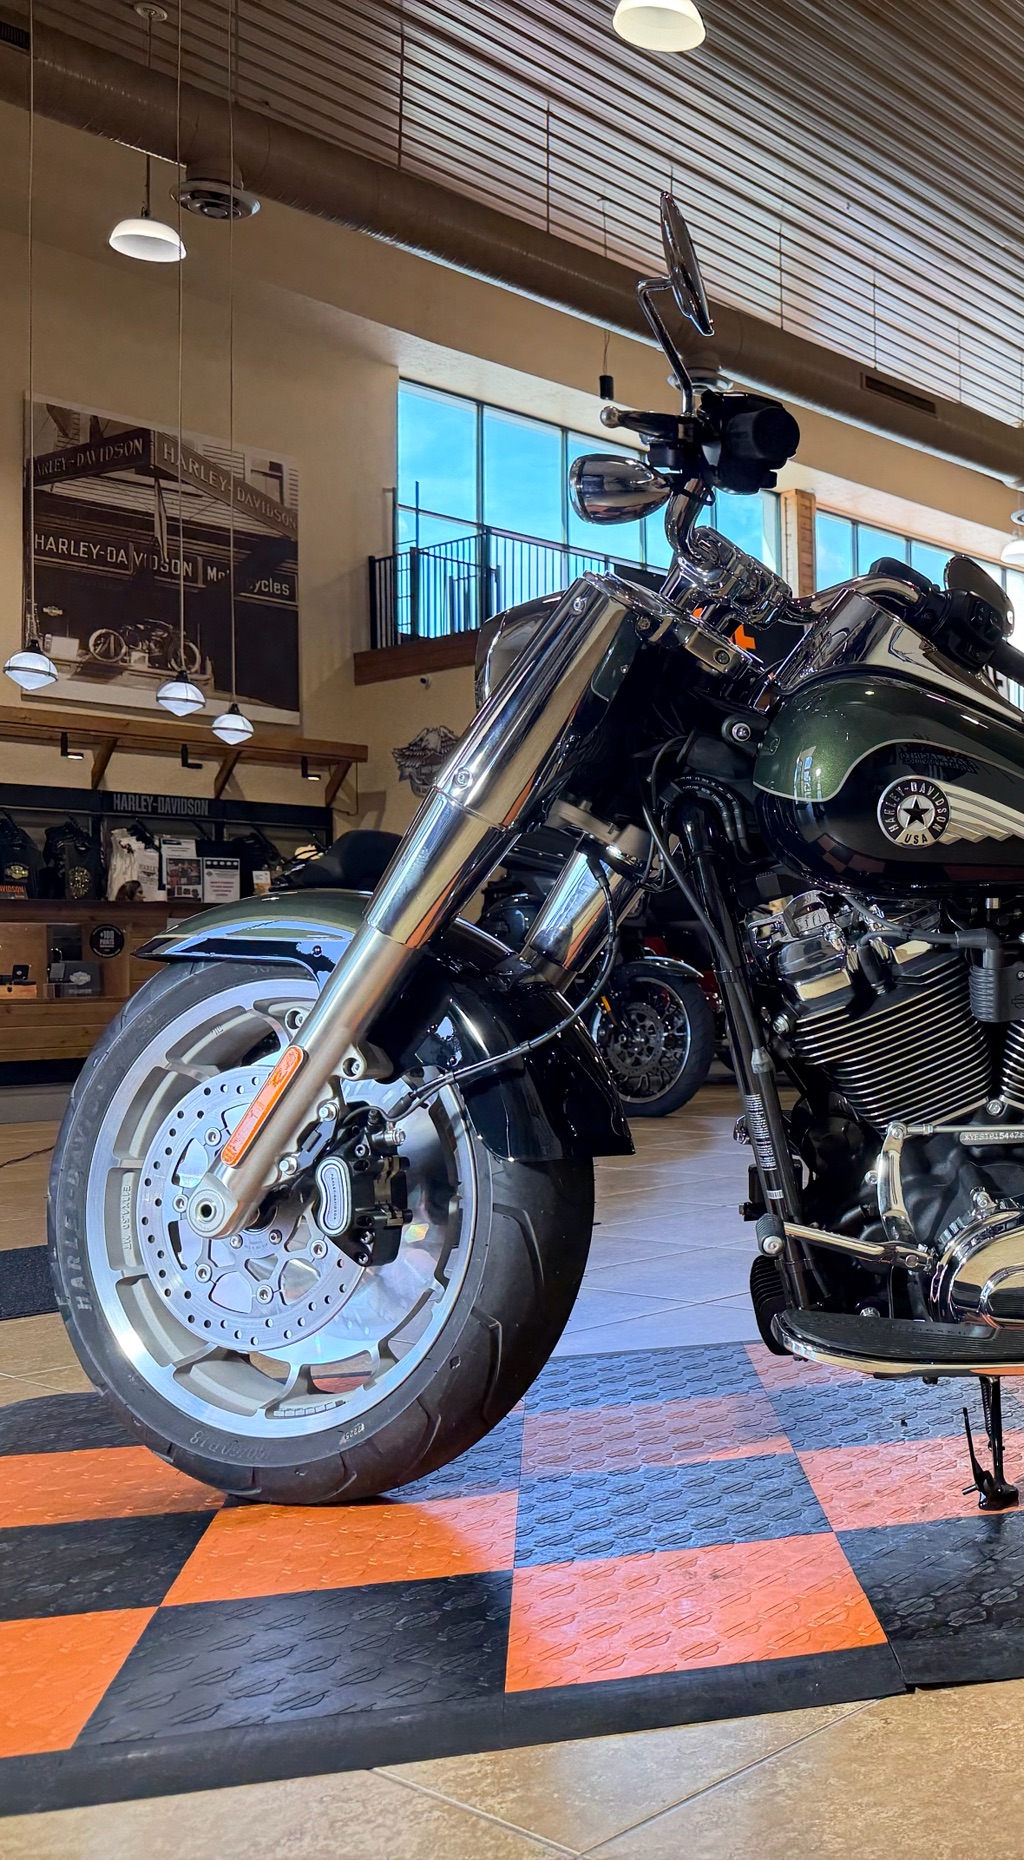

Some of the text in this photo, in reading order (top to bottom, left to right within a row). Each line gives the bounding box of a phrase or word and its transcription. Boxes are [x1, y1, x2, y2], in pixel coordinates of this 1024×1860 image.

[35, 438, 143, 476] ARLEY-DAVIDSON
[113, 793, 209, 816] HARLEY-DAVIDSON
[884, 781, 947, 832] HARLEY-DAVIDSON
[904, 833, 928, 844] USA
